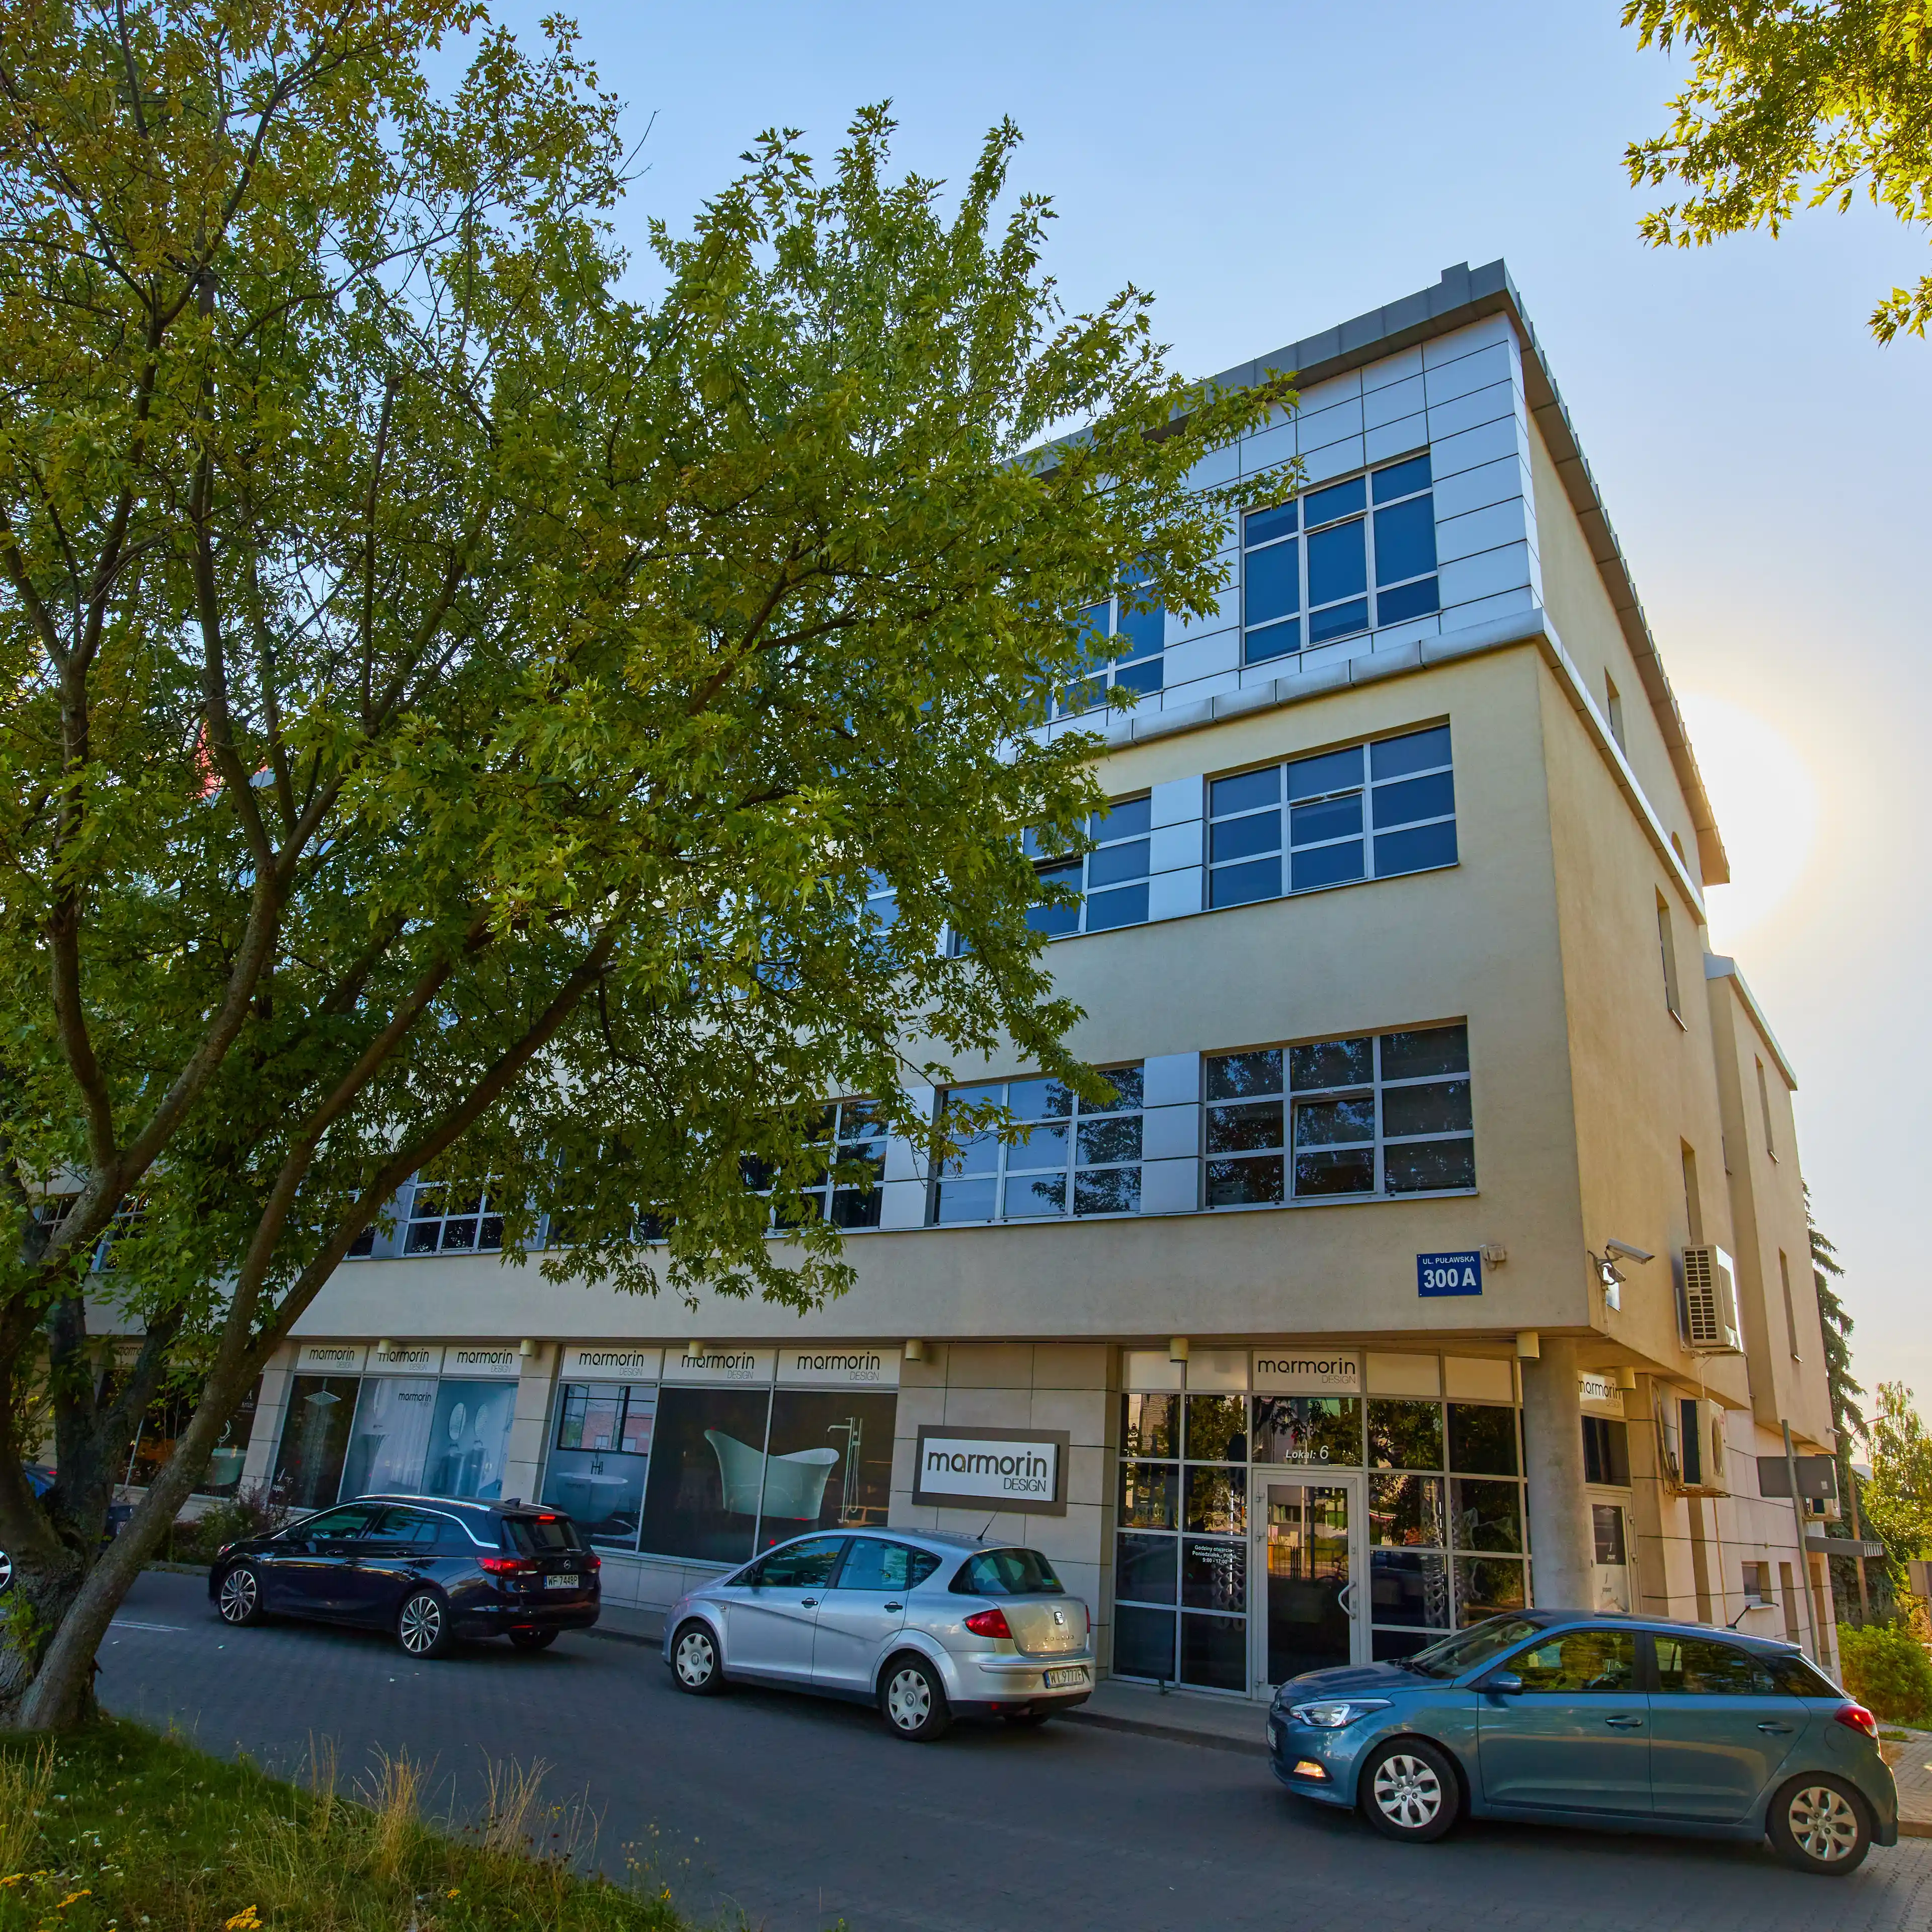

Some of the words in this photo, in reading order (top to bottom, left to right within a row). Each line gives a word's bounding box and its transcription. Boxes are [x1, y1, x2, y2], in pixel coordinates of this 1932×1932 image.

[1423, 1268, 1459, 1288] 300
[1462, 1268, 1476, 1286] A
[309, 1347, 355, 1360] marmorin
[457, 1349, 513, 1364] marmorin
[579, 1350, 643, 1367] marmorin
[336, 1361, 352, 1369] DESIGN
[797, 1351, 880, 1370] marmorin
[1258, 1357, 1355, 1375] marmorin
[409, 1363, 427, 1371] DESIGN
[491, 1364, 511, 1373] DESIGN
[619, 1367, 643, 1376] DESIGN
[727, 1370, 754, 1379] DESIGN
[850, 1371, 879, 1381] DESIGN
[1322, 1375, 1356, 1384] DESIGN
[398, 1392, 432, 1402] marmorin
[1285, 1449, 1316, 1459] Lokal:
[1320, 1445, 1329, 1459] 6
[927, 1451, 1046, 1478] marmorin
[1004, 1478, 1046, 1492] DESIGN
[548, 1576, 558, 1586] WF
